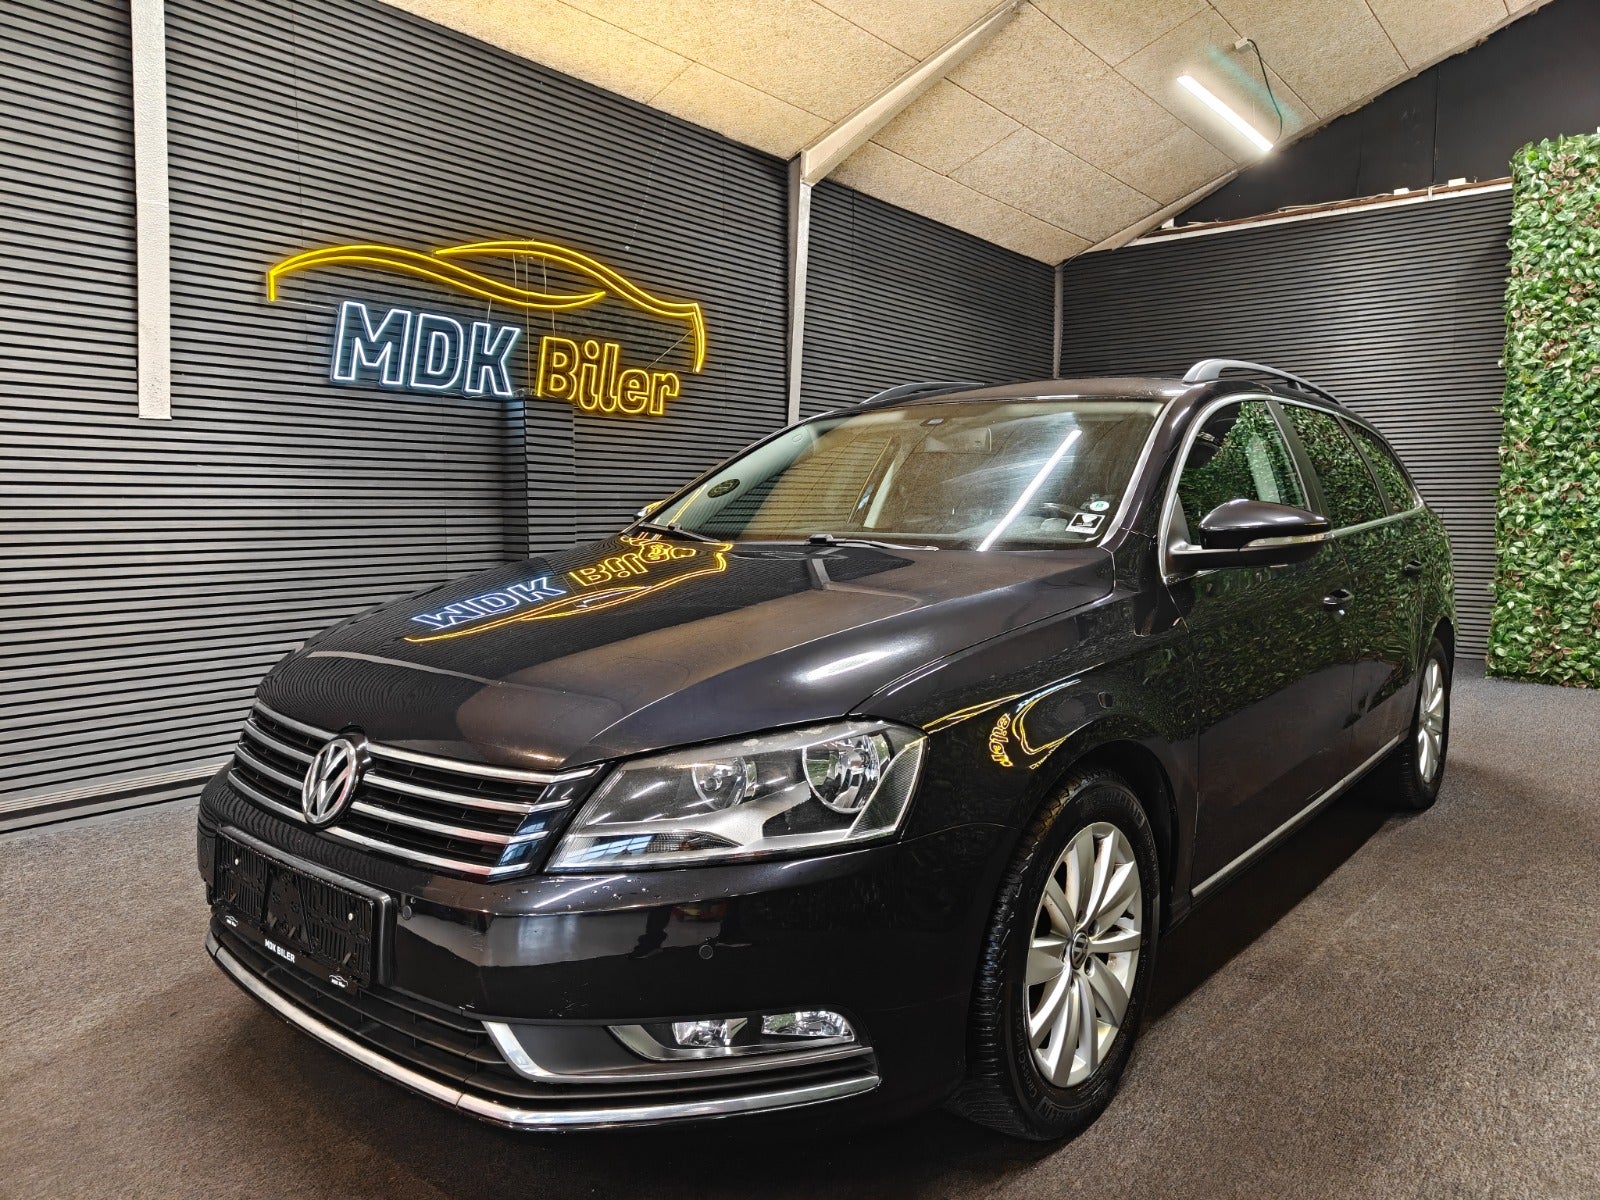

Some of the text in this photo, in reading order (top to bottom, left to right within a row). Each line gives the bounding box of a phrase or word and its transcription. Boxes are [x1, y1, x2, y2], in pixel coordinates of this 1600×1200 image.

[332, 299, 681, 415] MDK Biler
[276, 945, 296, 964] BILER
